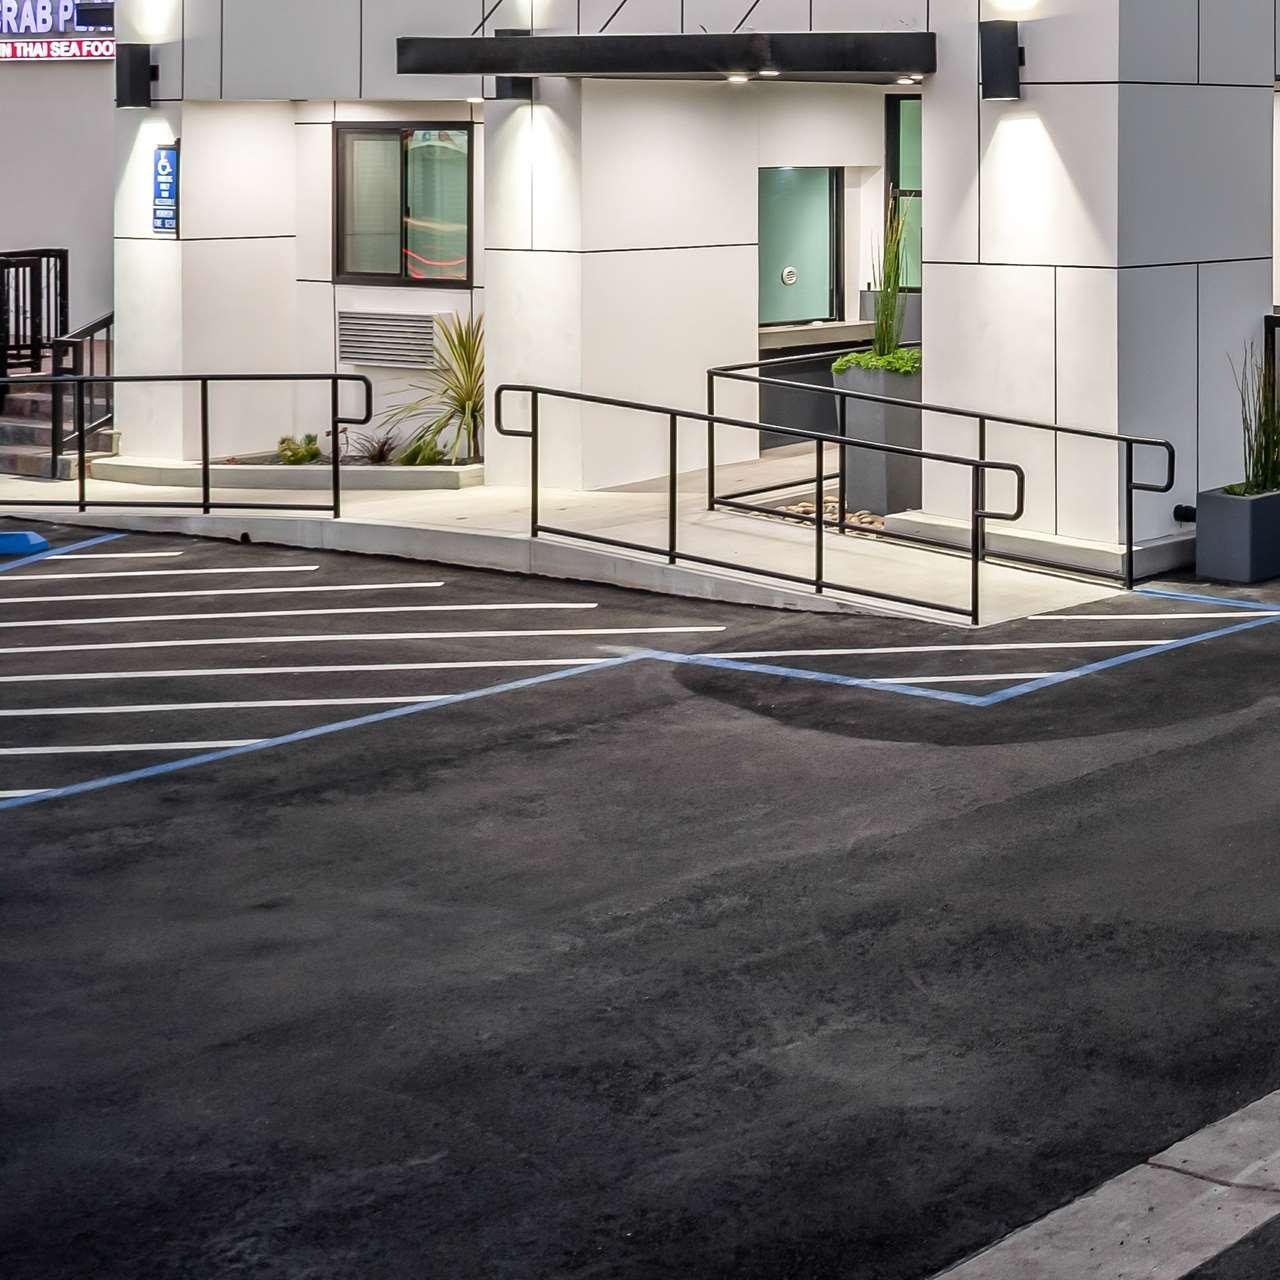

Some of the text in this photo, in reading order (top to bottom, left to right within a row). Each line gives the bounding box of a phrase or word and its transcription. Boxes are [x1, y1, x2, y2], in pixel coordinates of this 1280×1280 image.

[14, 41, 49, 57] THAI
[50, 41, 80, 56] SEA
[82, 40, 115, 56] FOO
